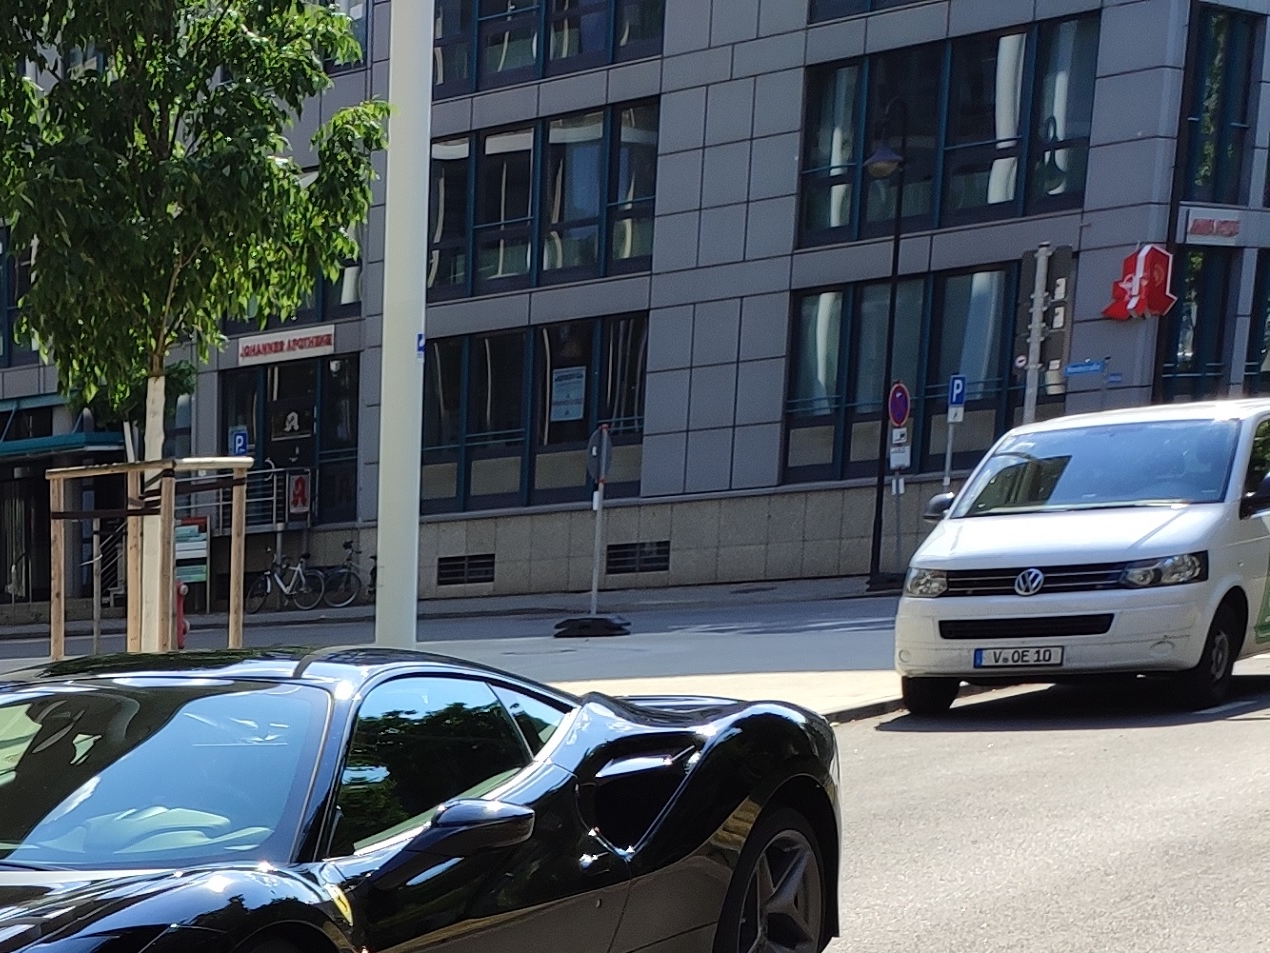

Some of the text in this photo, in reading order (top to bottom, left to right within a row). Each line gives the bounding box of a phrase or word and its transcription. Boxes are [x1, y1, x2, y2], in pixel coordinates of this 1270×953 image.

[952, 380, 963, 402] P
[236, 435, 244, 454] P
[1011, 650, 1029, 663] OE
[1033, 649, 1052, 662] 10
